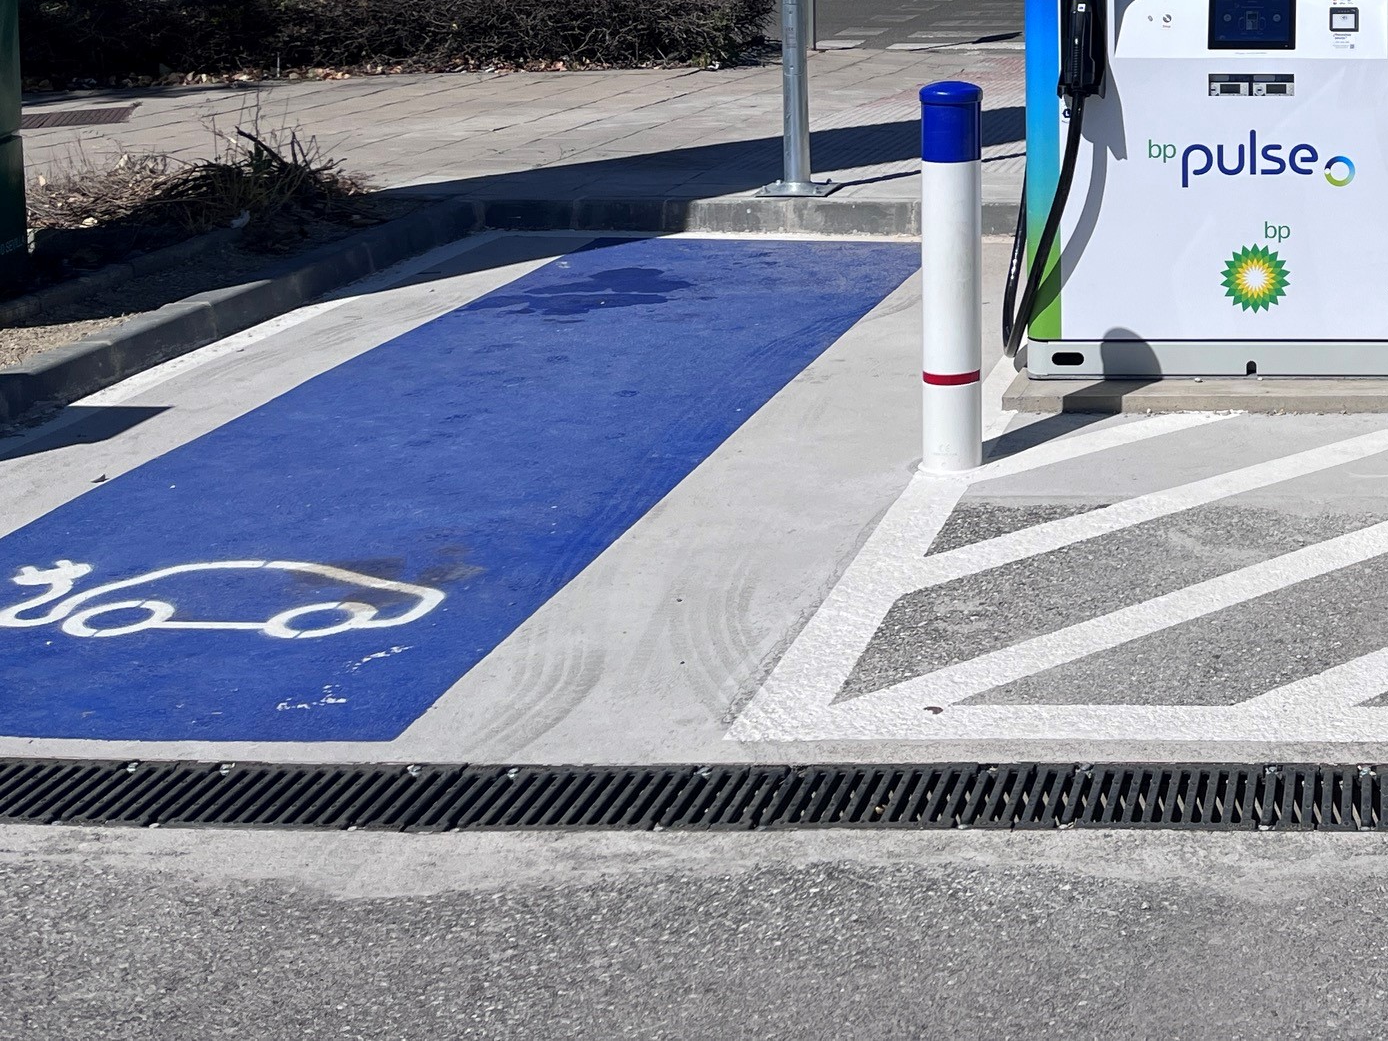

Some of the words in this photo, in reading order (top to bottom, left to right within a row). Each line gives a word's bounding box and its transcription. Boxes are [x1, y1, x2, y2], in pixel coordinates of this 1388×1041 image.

[1148, 139, 1177, 163] bp
[1181, 129, 1319, 188] pulse
[1264, 221, 1291, 243] bp
